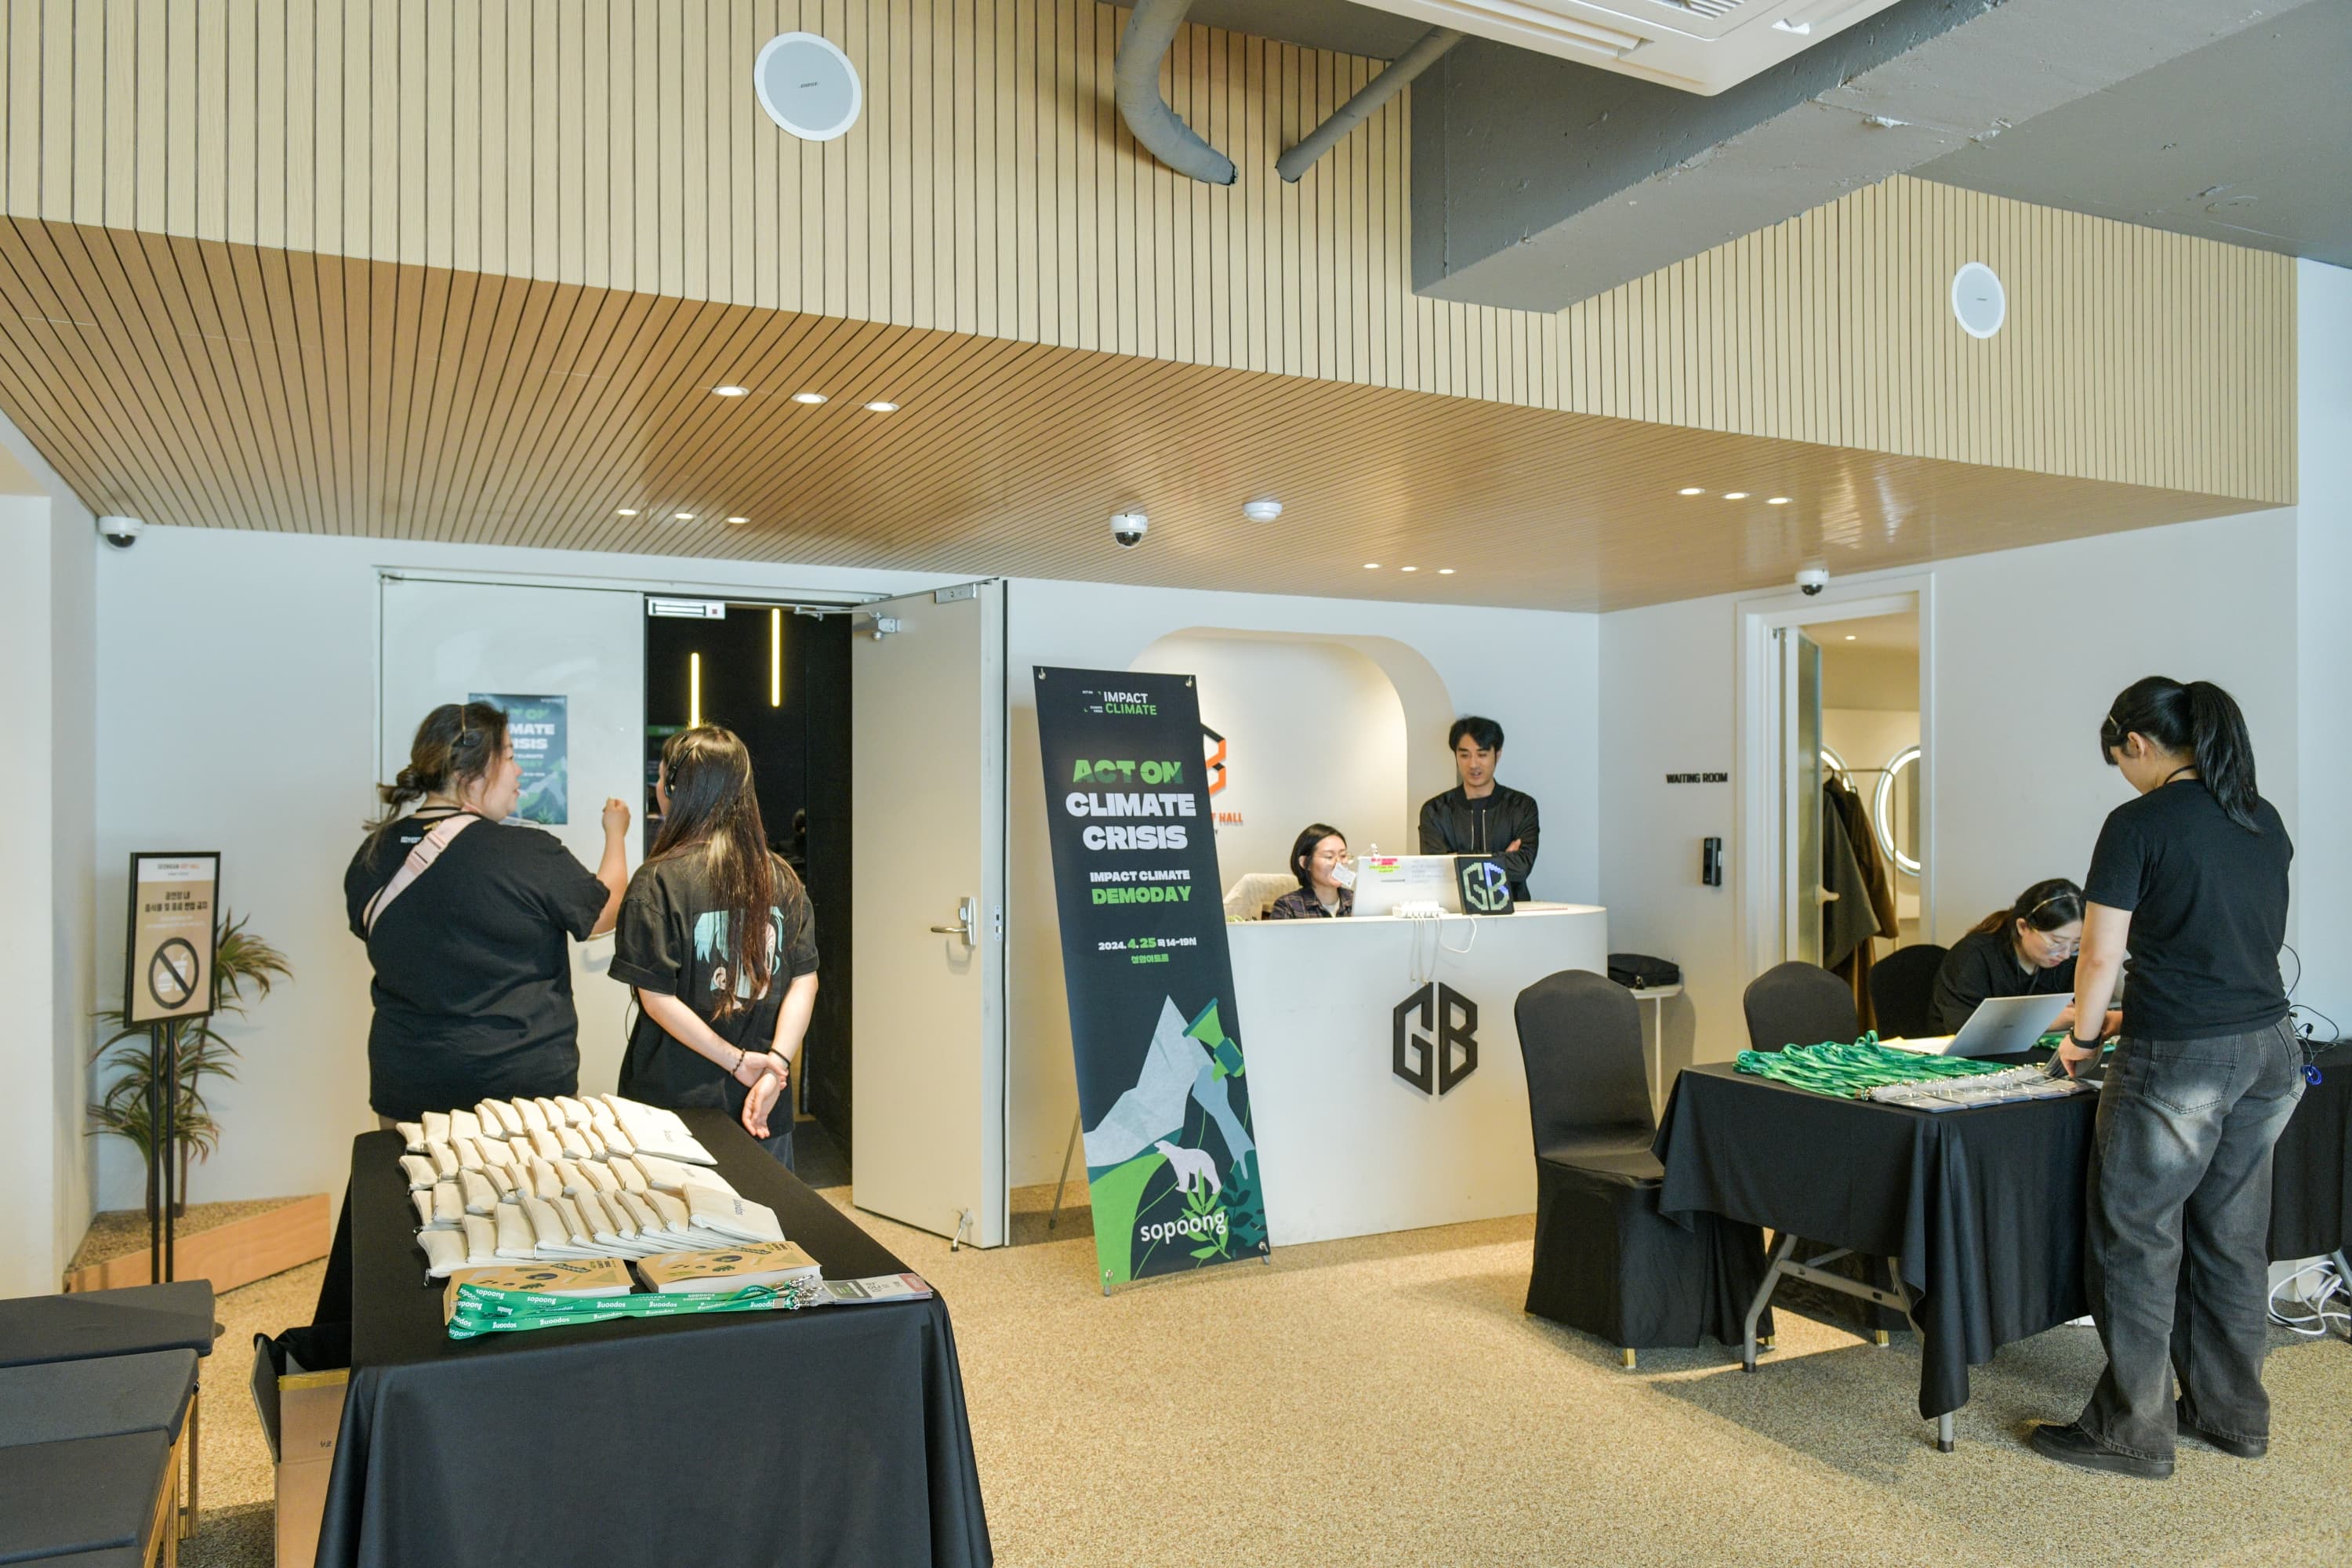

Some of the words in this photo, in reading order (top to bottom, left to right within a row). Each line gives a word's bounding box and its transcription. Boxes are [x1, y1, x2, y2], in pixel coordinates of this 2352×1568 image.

[1104, 691, 1148, 704] IMPACT
[1105, 702, 1157, 715] CLIMATE
[1073, 760, 1136, 783] ACT
[1140, 760, 1184, 784] ON
[1667, 773, 1700, 783] WAITING
[1703, 772, 1728, 782] ROOM
[1065, 792, 1196, 817] CLIMATE
[1219, 812, 1243, 822] HALL
[1083, 826, 1188, 851] CRISIS
[1090, 871, 1137, 882] IMPACT
[1139, 869, 1191, 881] CLIMATE
[1463, 862, 1509, 910] GB
[1091, 886, 1191, 904] DEMODAY
[1098, 942, 1127, 950] 2024.
[1393, 982, 1477, 1095] GB
[1141, 1211, 1226, 1244] sopoong
[527, 1296, 556, 1305] sopoong
